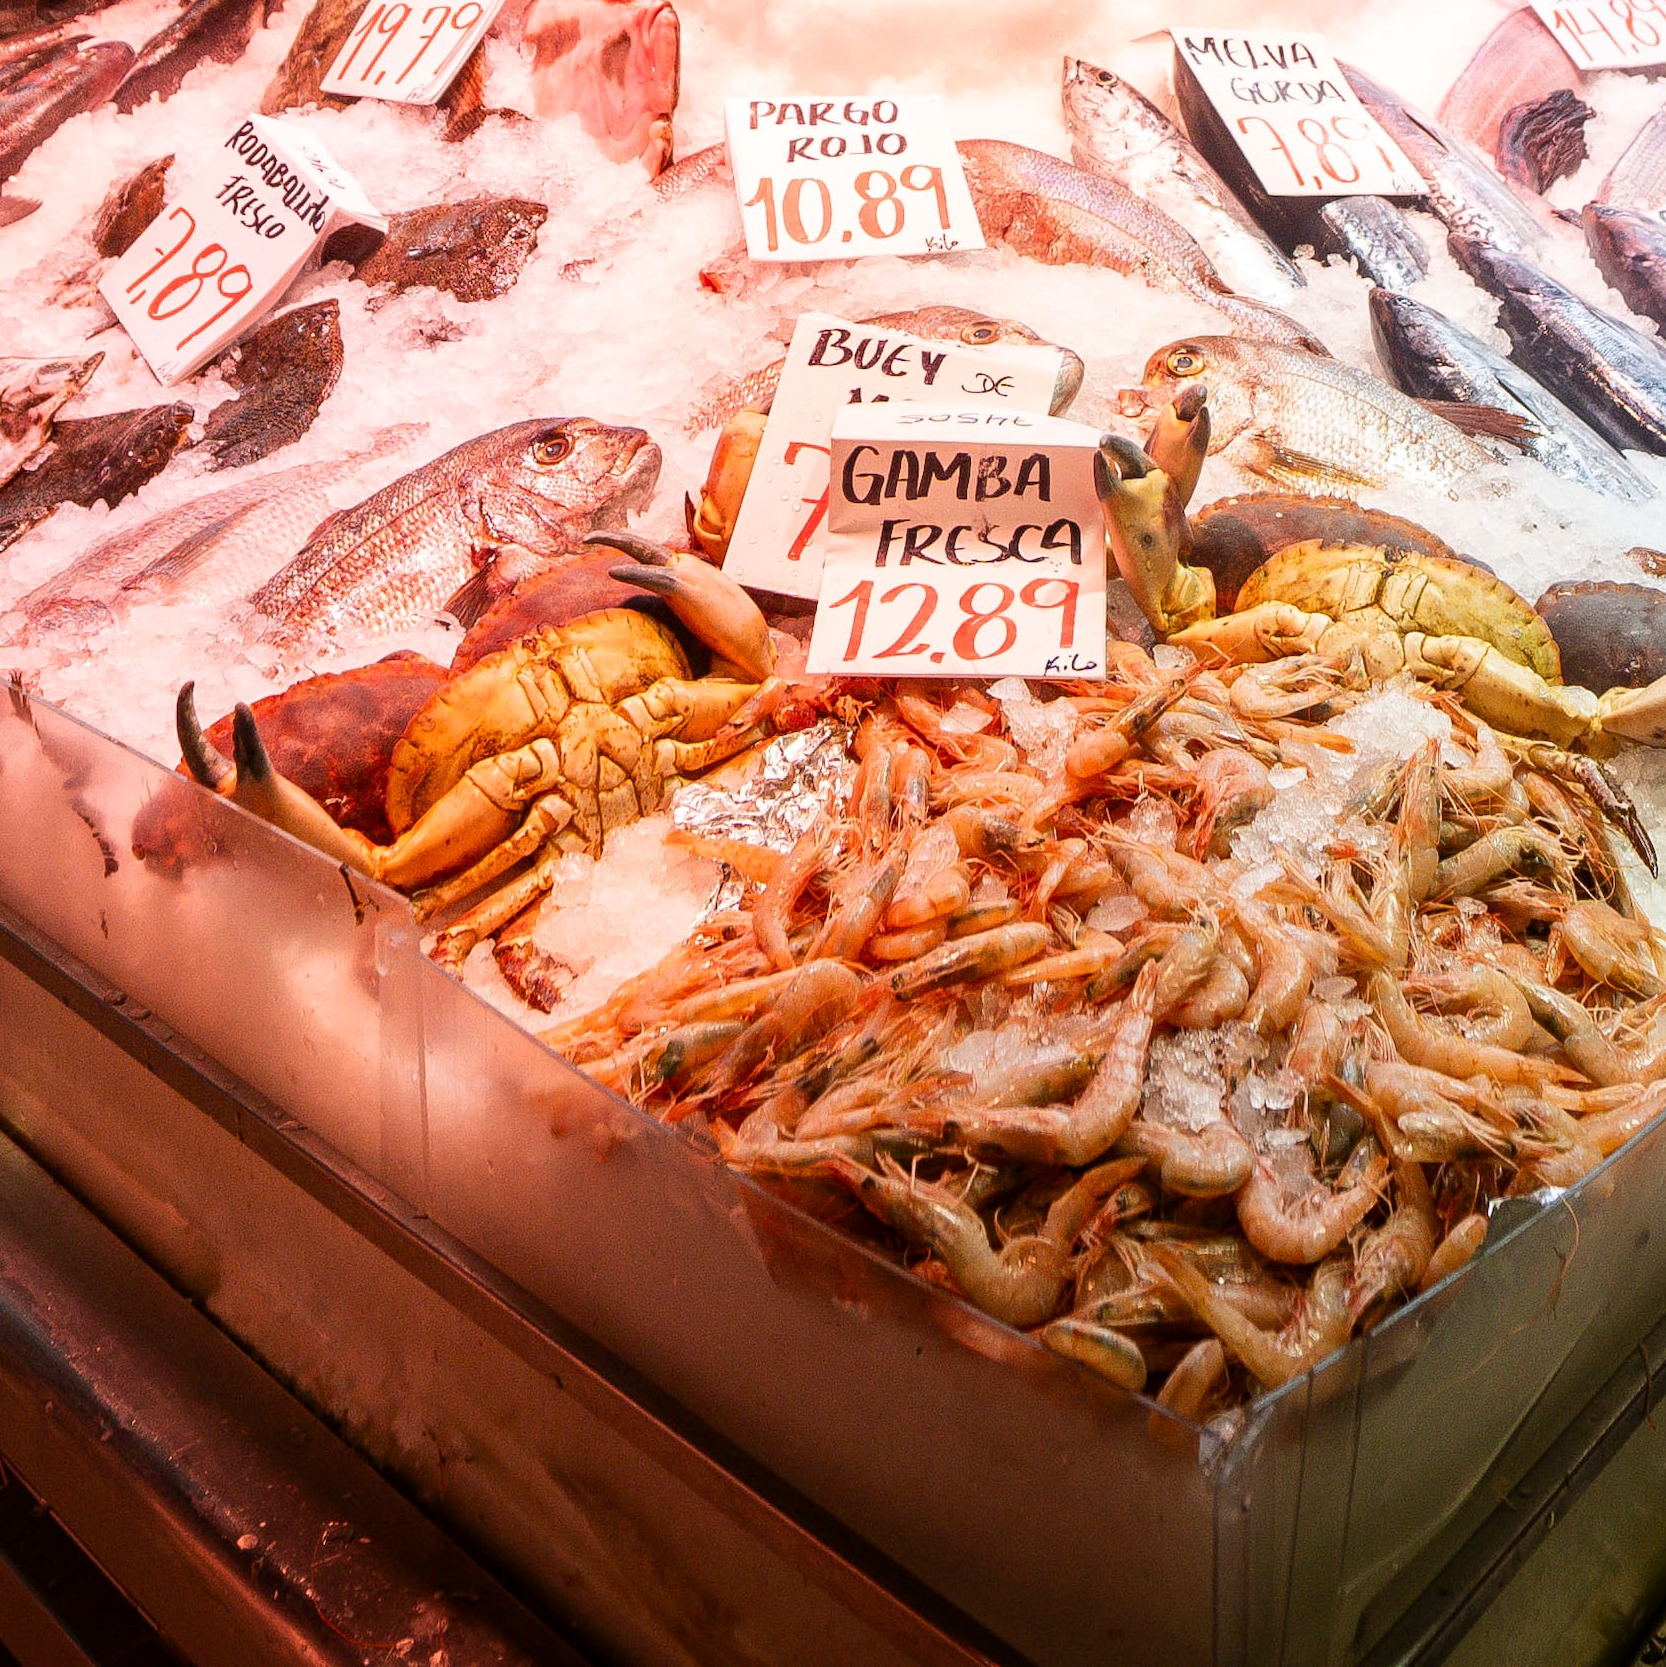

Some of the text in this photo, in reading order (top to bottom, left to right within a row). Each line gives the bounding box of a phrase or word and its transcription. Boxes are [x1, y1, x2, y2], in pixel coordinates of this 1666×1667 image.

[1184, 36, 1319, 70] MELVA
[1230, 76, 1347, 105] GORDA
[748, 99, 899, 130] PARGO
[785, 132, 908, 163] ROJO
[806, 327, 1016, 398] BUEY DE
[841, 444, 1052, 506] GAMBA
[873, 517, 1084, 569] FRESCA
